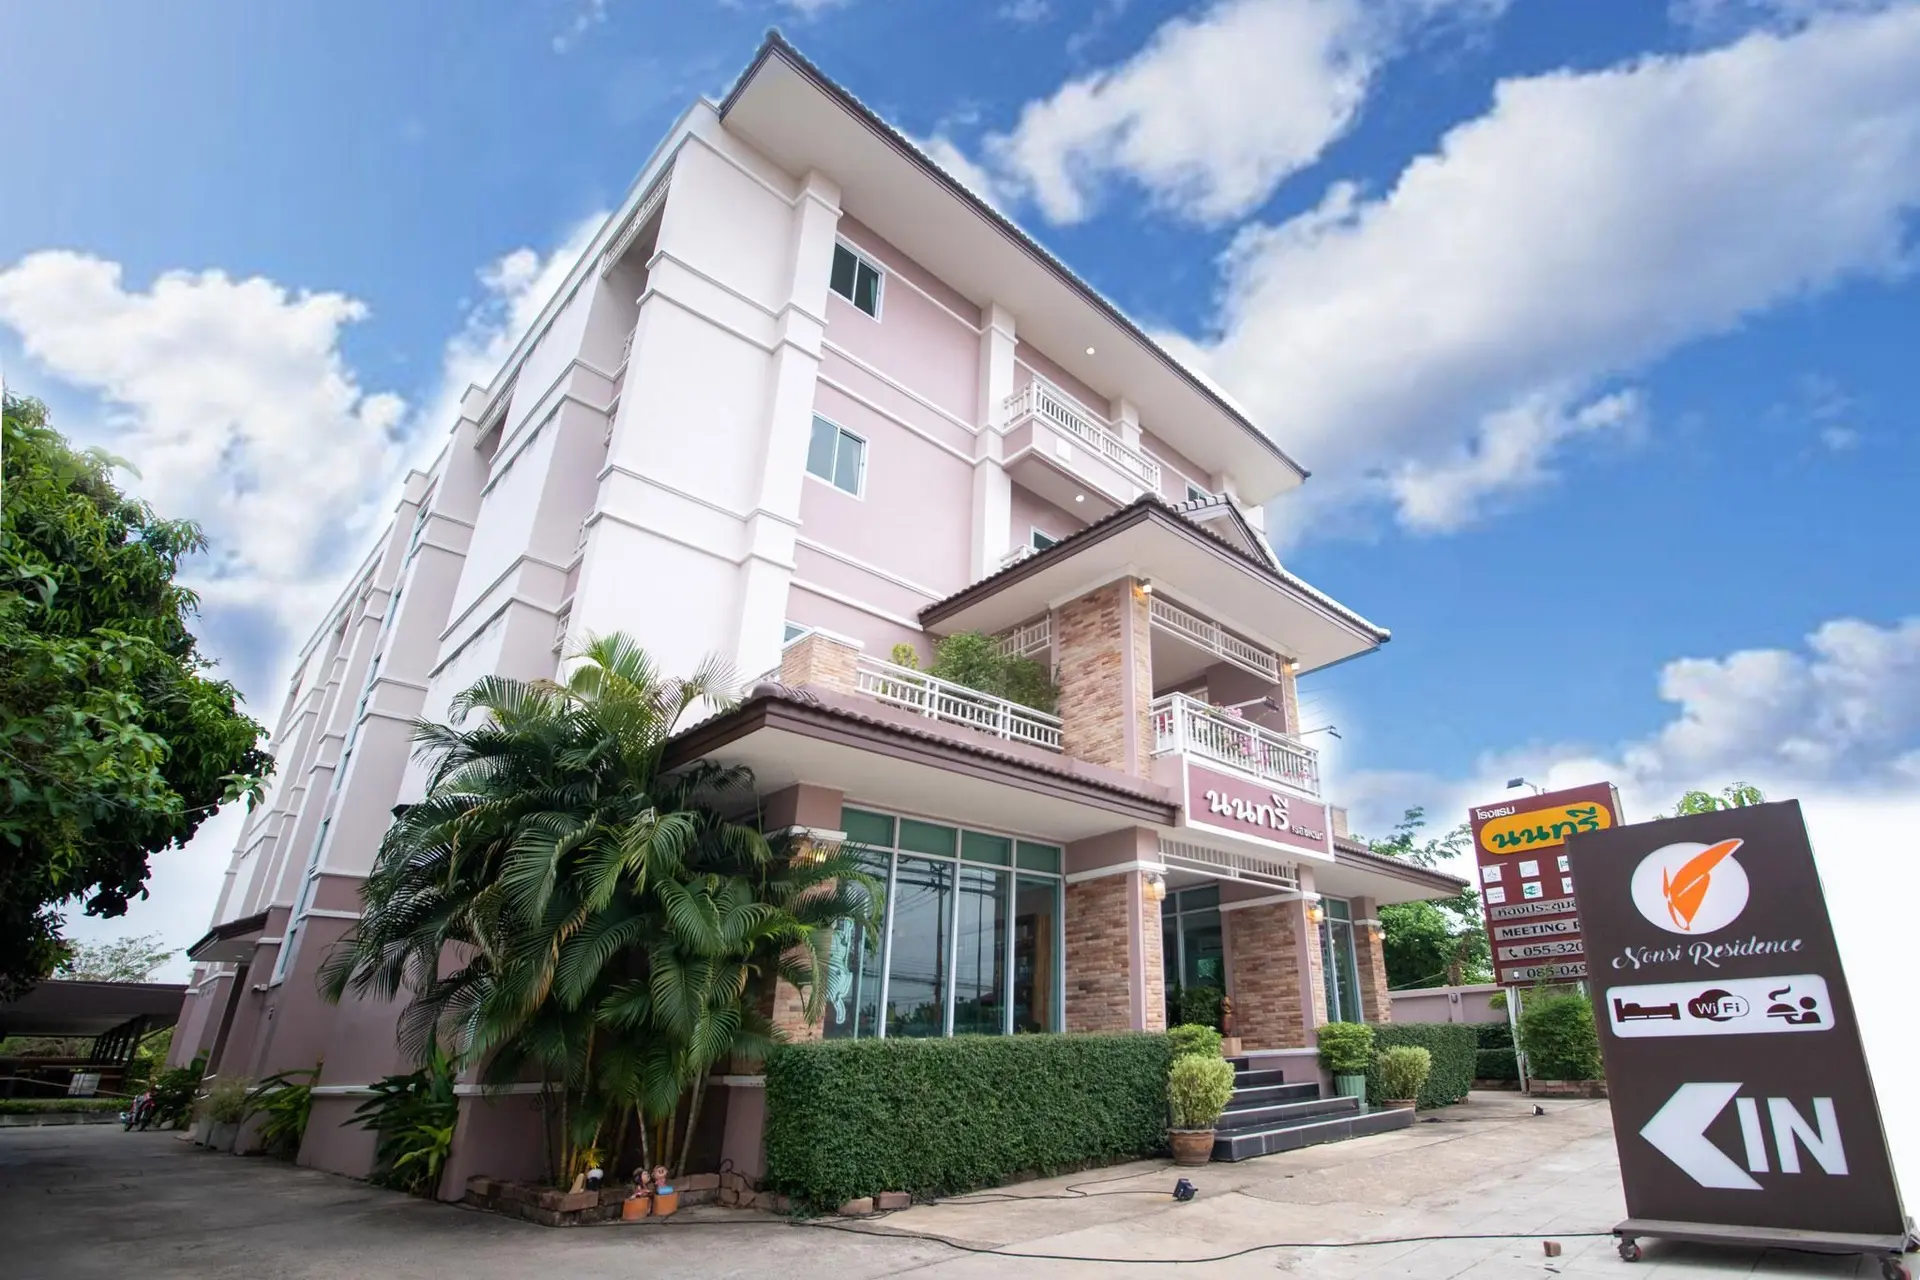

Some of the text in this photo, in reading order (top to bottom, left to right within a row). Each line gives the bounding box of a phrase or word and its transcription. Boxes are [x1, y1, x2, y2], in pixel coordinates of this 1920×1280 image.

[1205, 789, 1290, 830] นนทรี
[1476, 806, 1516, 820] โรงแรม
[1492, 806, 1600, 848] นนทรี
[1501, 922, 1567, 938] MEETING
[1612, 935, 1803, 970] Nonsi Residence
[1735, 1096, 1849, 1176] IN
